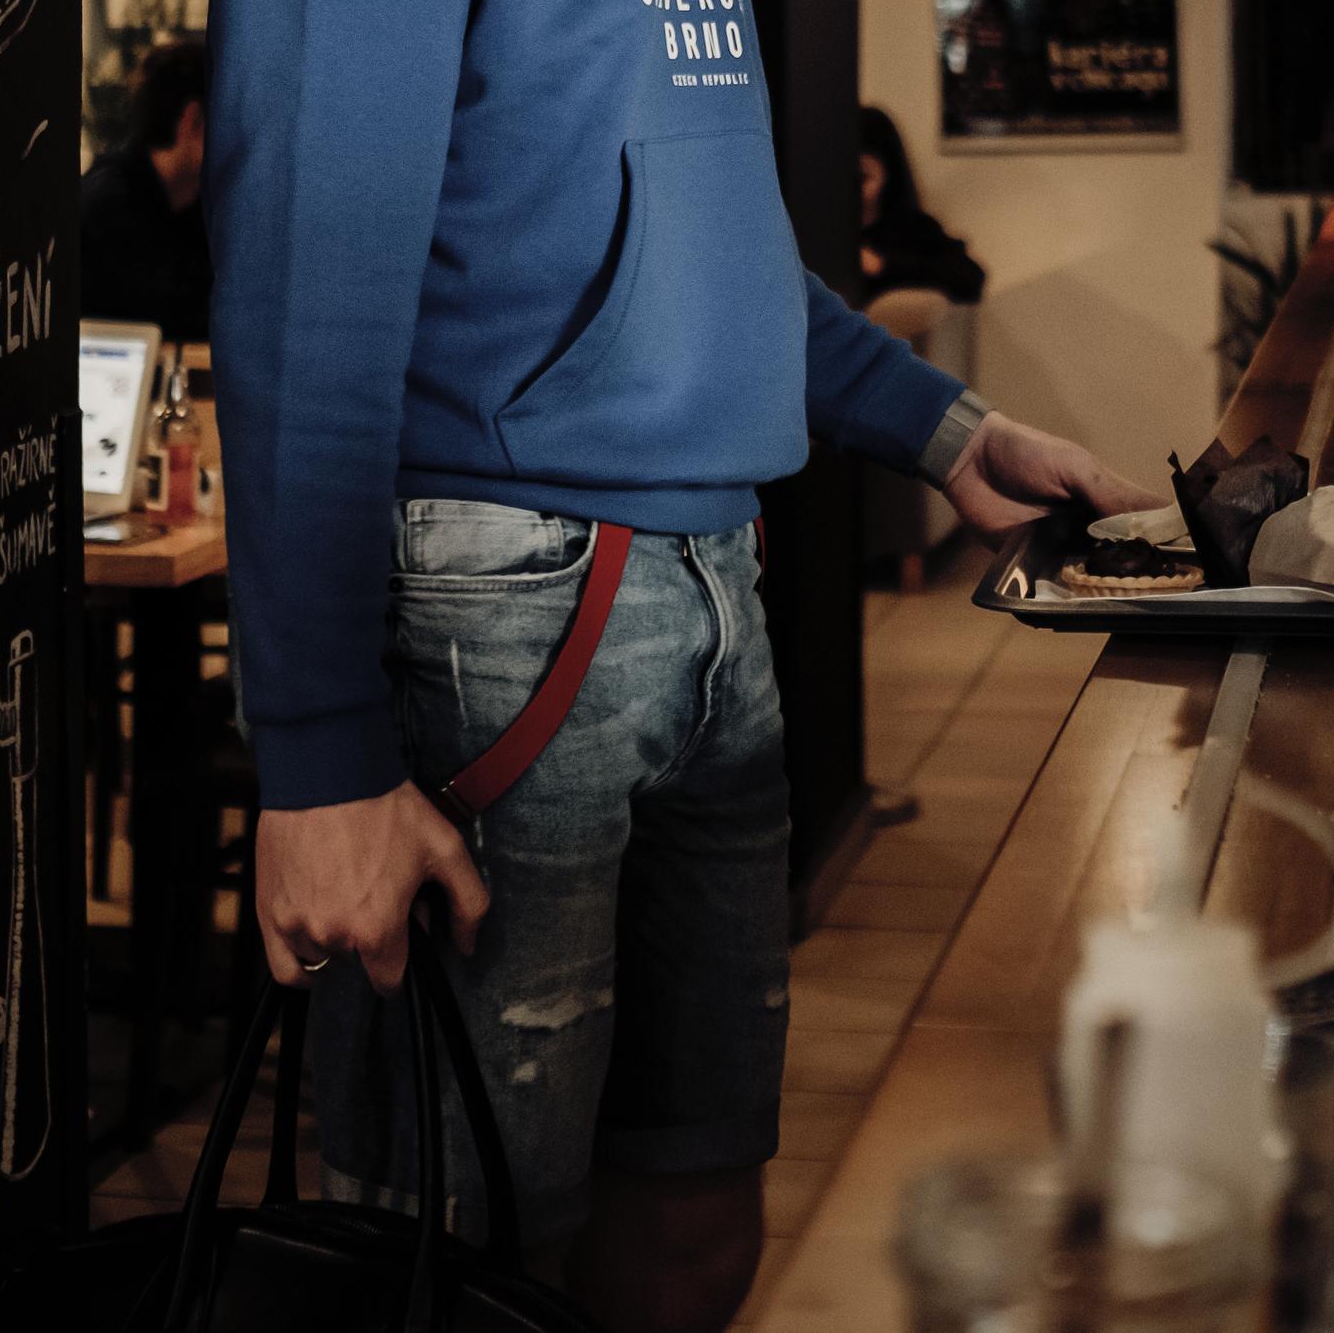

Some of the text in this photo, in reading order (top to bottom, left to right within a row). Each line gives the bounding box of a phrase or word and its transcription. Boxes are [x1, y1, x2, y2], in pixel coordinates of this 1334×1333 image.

[664, 21, 743, 60] BRNO
[672, 73, 749, 87] CZECH REPUBLIC
